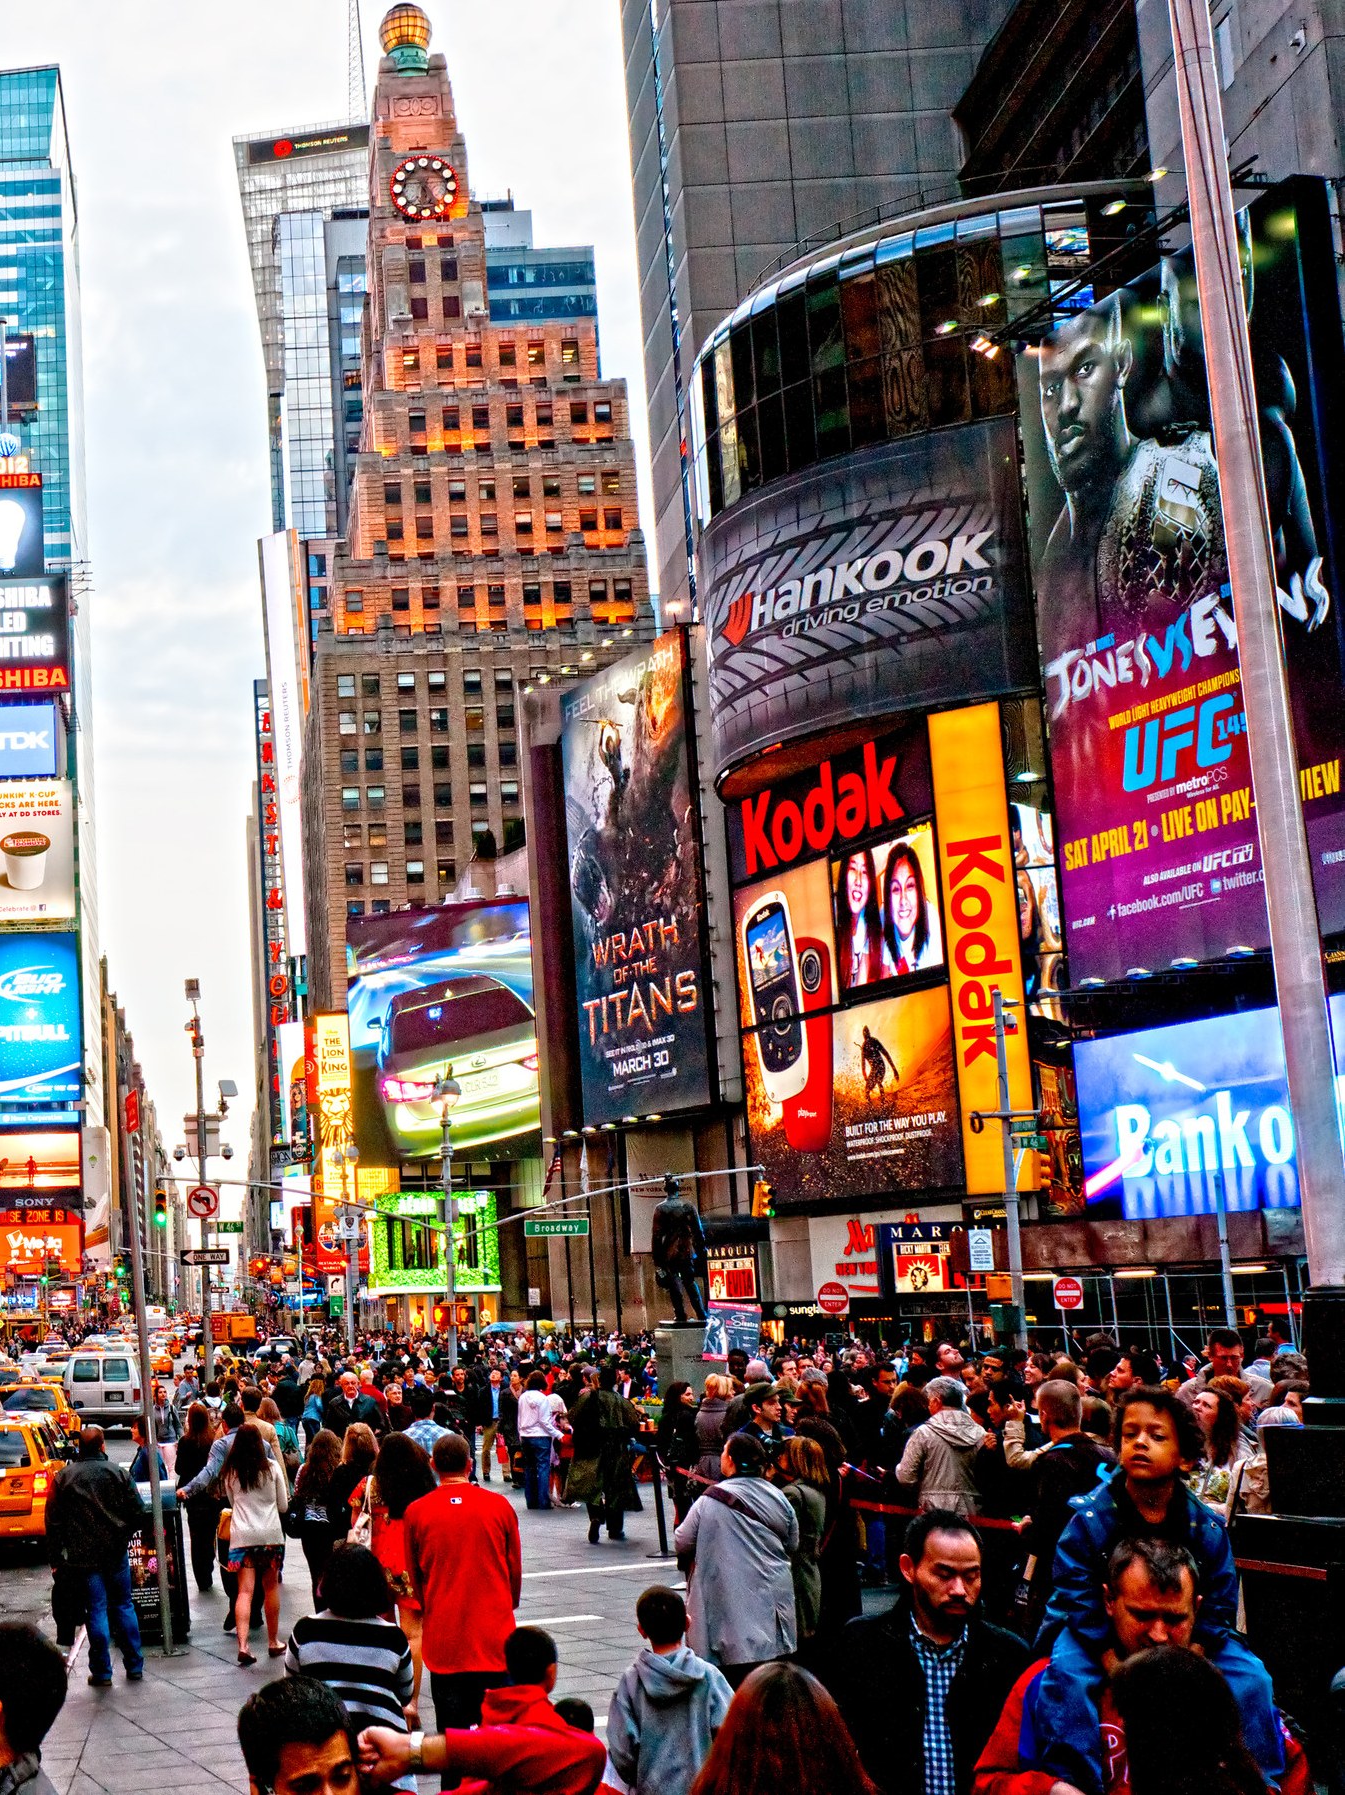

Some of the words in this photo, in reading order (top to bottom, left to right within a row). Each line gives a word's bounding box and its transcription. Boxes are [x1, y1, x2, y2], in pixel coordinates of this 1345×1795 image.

[294, 140, 322, 149] THOMSON
[322, 135, 348, 145] REUTERS
[782, 603, 859, 640] driving
[865, 575, 993, 614] emotion
[1045, 632, 1152, 722] JONES
[1145, 611, 1193, 679] VS
[1189, 556, 1331, 659] EVNS
[564, 693, 596, 723] FEEL
[624, 644, 674, 680] WRATH
[1108, 711, 1131, 731] WORLD
[1131, 707, 1150, 725] LIGHT
[1150, 685, 1196, 717] HEAVYWEIGHT
[1122, 692, 1235, 793] UFC
[261, 711, 279, 856] ERNST
[32, 809, 62, 817] STORES.
[37, 800, 62, 808] HERE.
[741, 741, 905, 876] Kodak
[1063, 838, 1090, 871] SAT
[1091, 824, 1132, 863] APRIL
[1133, 819, 1148, 850] 21
[1160, 805, 1194, 843] LIVE
[1195, 798, 1215, 832] ON
[1220, 786, 1257, 825] PAY-
[1142, 874, 1158, 887] ALSO
[1159, 864, 1191, 882] AVAILABLE
[1192, 861, 1202, 872] ON
[1116, 881, 1205, 917] facebook.com/UFC
[591, 914, 680, 969] WRATH
[945, 834, 1019, 1068] Kodak
[613, 967, 628, 985] OF
[632, 956, 658, 977] THE
[581, 970, 698, 1047] TITANS
[321, 1048, 345, 1060] LION
[324, 1037, 341, 1046] THE
[320, 1061, 348, 1075] KING
[612, 1054, 651, 1077] MARCH
[653, 1050, 670, 1071] 30
[845, 1124, 864, 1138] BUILT
[864, 1121, 878, 1134] FOR
[879, 1119, 893, 1132] THE
[893, 1116, 910, 1130] WAY
[910, 1113, 927, 1128] YOU
[928, 1110, 948, 1126] PLAY.
[14, 1197, 55, 1208] SONY
[25, 1209, 51, 1223] ZONE
[54, 1209, 66, 1222] IS
[218, 1222, 225, 1233] W
[226, 1222, 235, 1233] 46
[534, 1223, 580, 1233] Broadway
[192, 1253, 207, 1261] ONE
[209, 1252, 225, 1260] WAY
[706, 1245, 755, 1258] MARQUIS
[914, 1243, 932, 1255] MARTIN
[835, 1262, 855, 1276] NEW
[726, 1268, 755, 1298] EVITA
